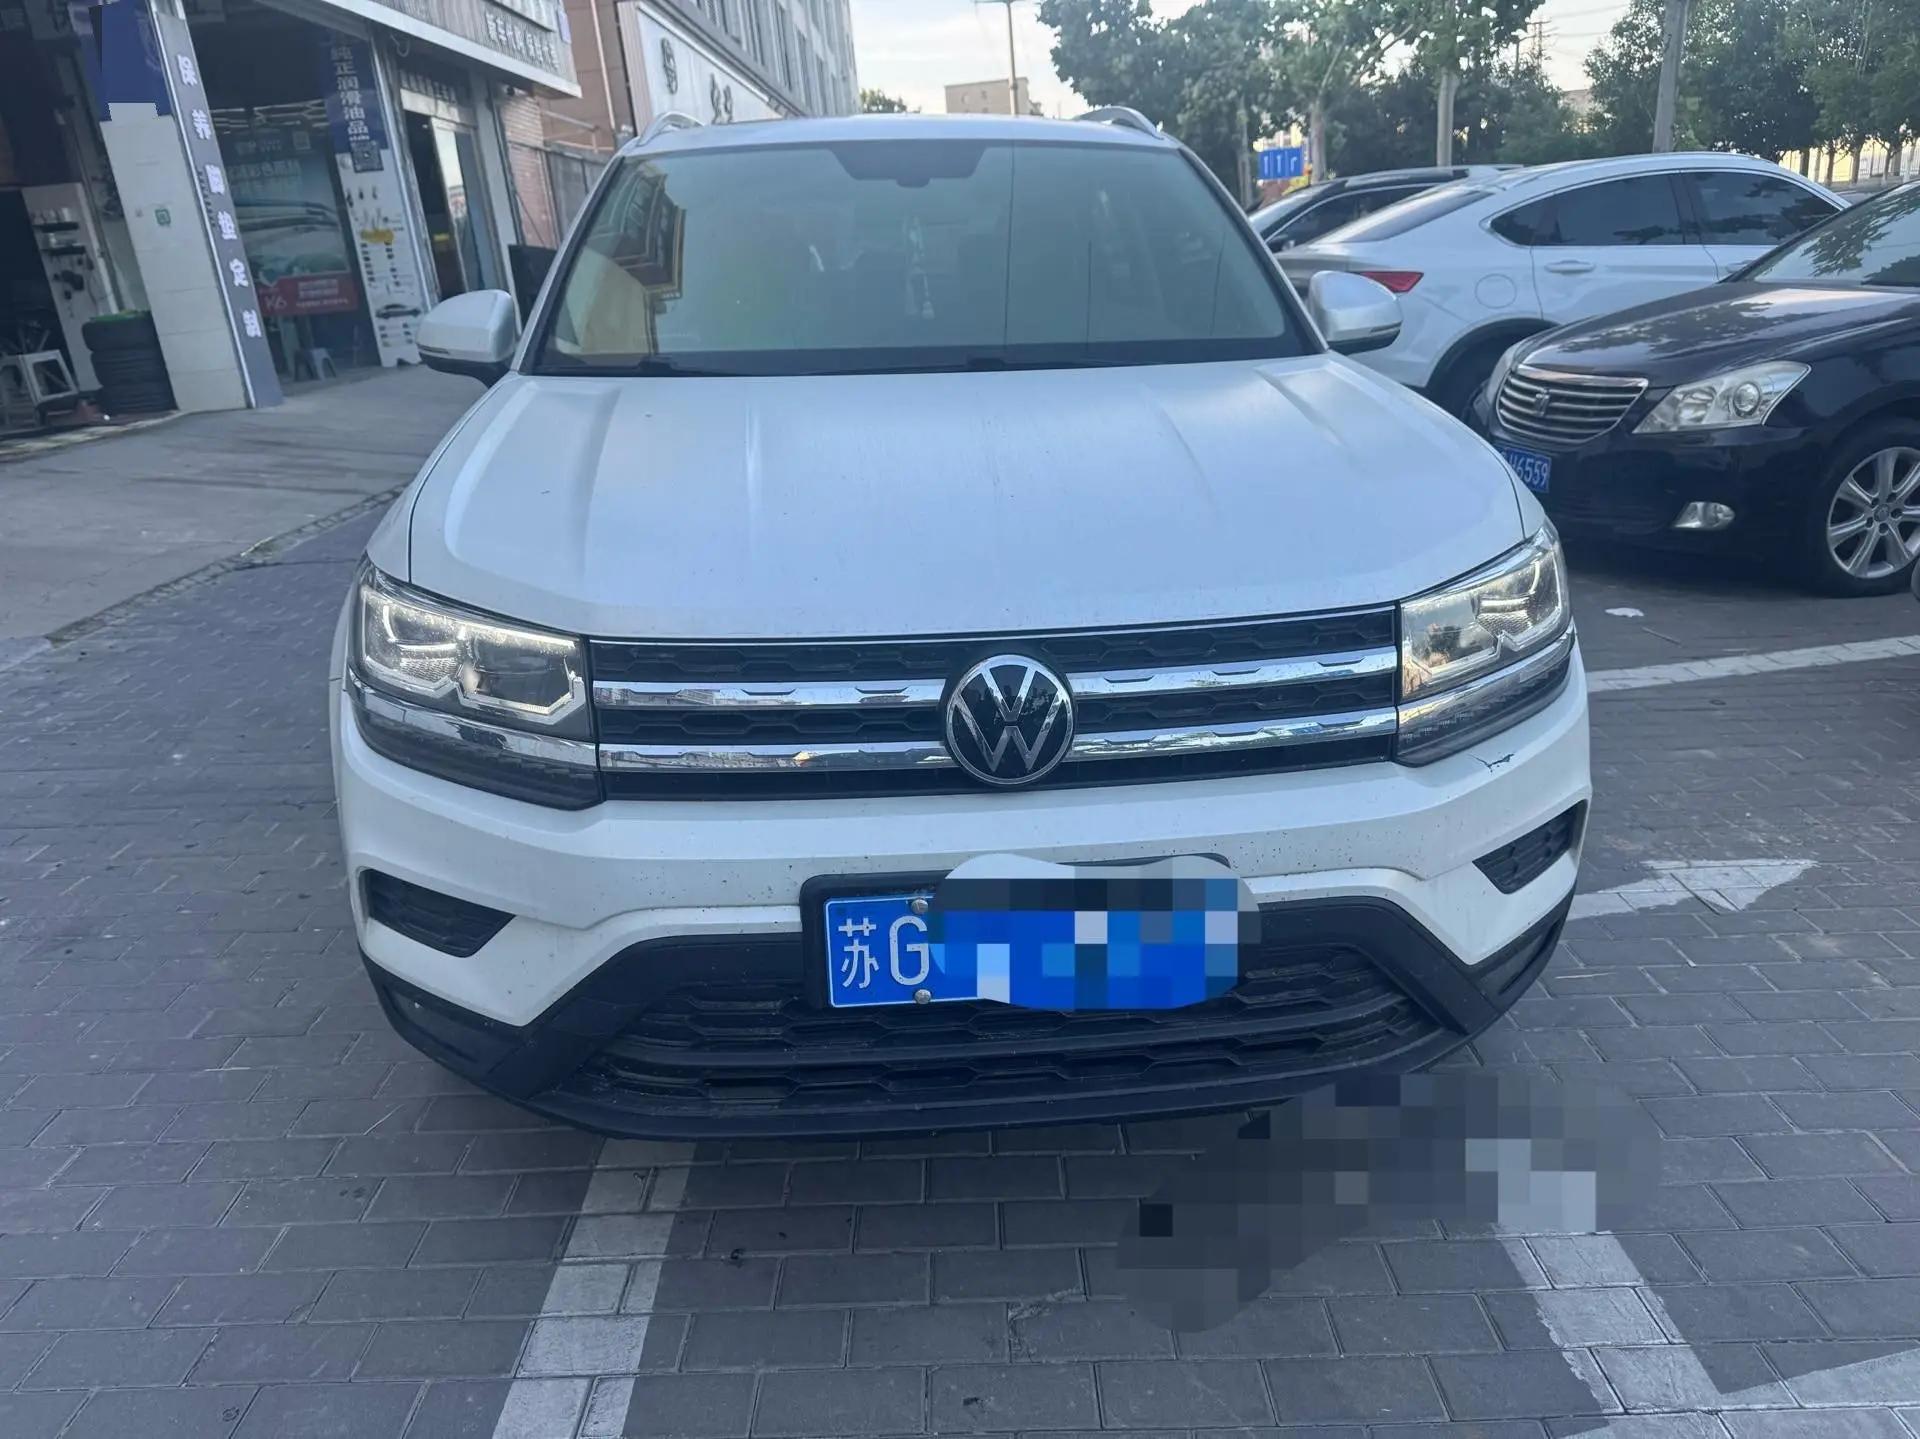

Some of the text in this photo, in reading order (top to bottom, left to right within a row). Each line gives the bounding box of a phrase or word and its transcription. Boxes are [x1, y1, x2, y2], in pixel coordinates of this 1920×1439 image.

[330, 45, 369, 136] 纯正润滑油品
[176, 53, 262, 339] 保养脚垫定制
